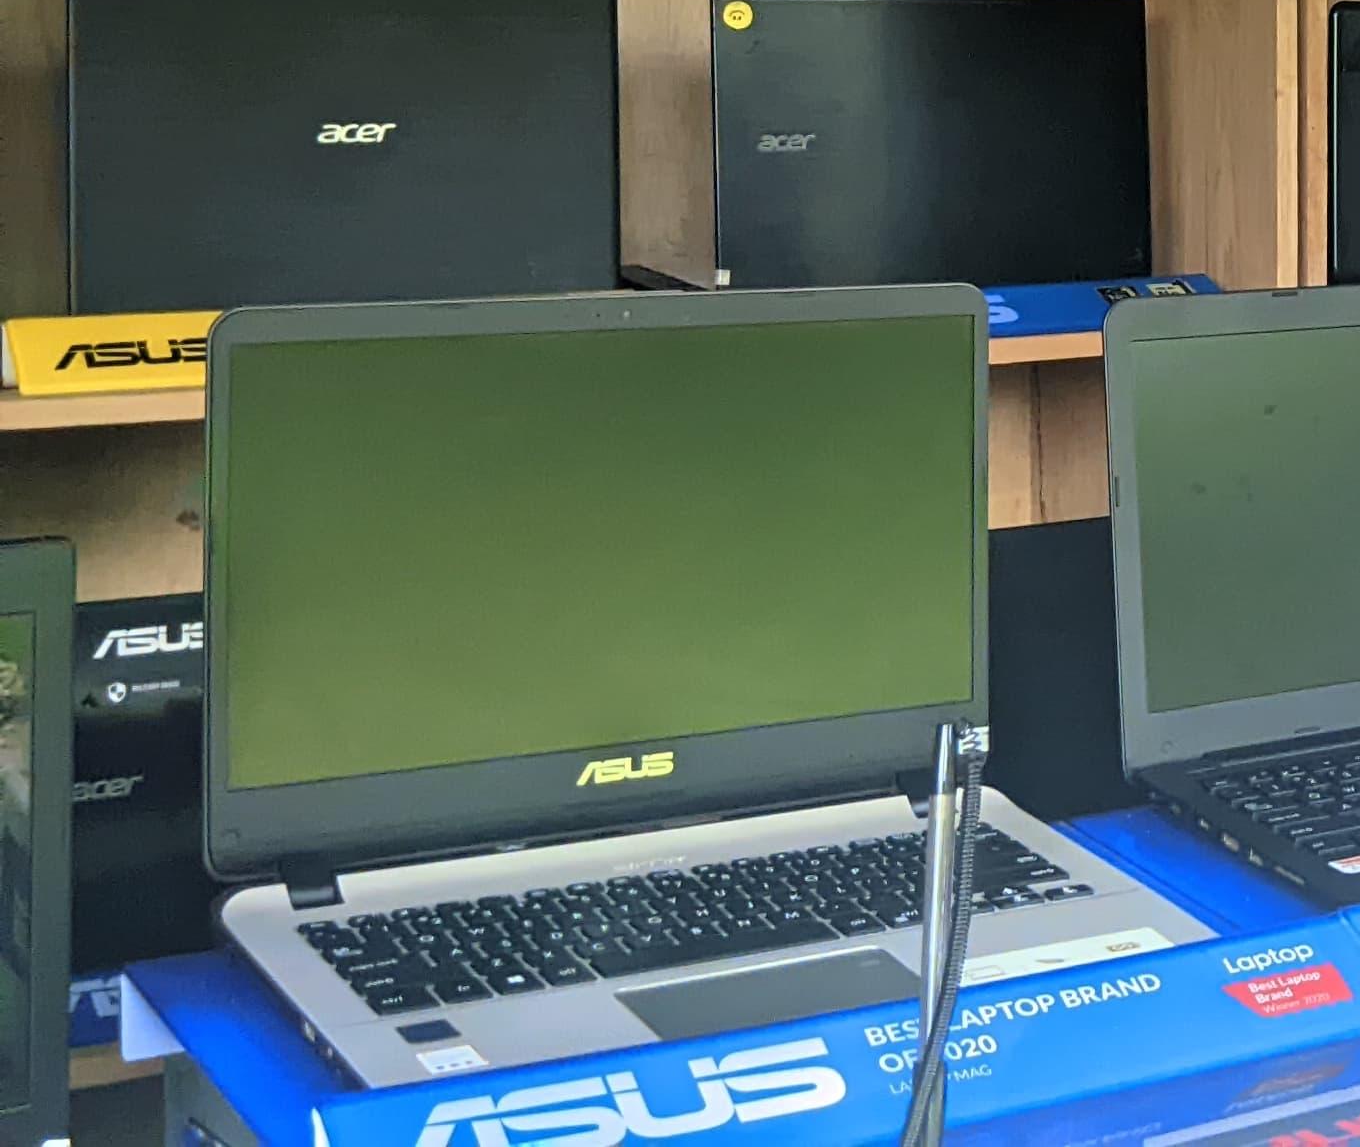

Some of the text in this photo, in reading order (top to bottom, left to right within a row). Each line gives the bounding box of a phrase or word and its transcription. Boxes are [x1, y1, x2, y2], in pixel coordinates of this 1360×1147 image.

[317, 121, 396, 144] acer
[757, 132, 816, 153] acer
[575, 751, 674, 787] ASUS
[1222, 944, 1315, 975] Laptop
[1247, 972, 1322, 994] Best Laptop
[1254, 987, 1294, 1005] Brand
[864, 972, 1162, 1047] BES BRAND
[943, 1034, 998, 1062] 020
[954, 1064, 993, 1082] MAG
[412, 1037, 848, 1147] ASUS
